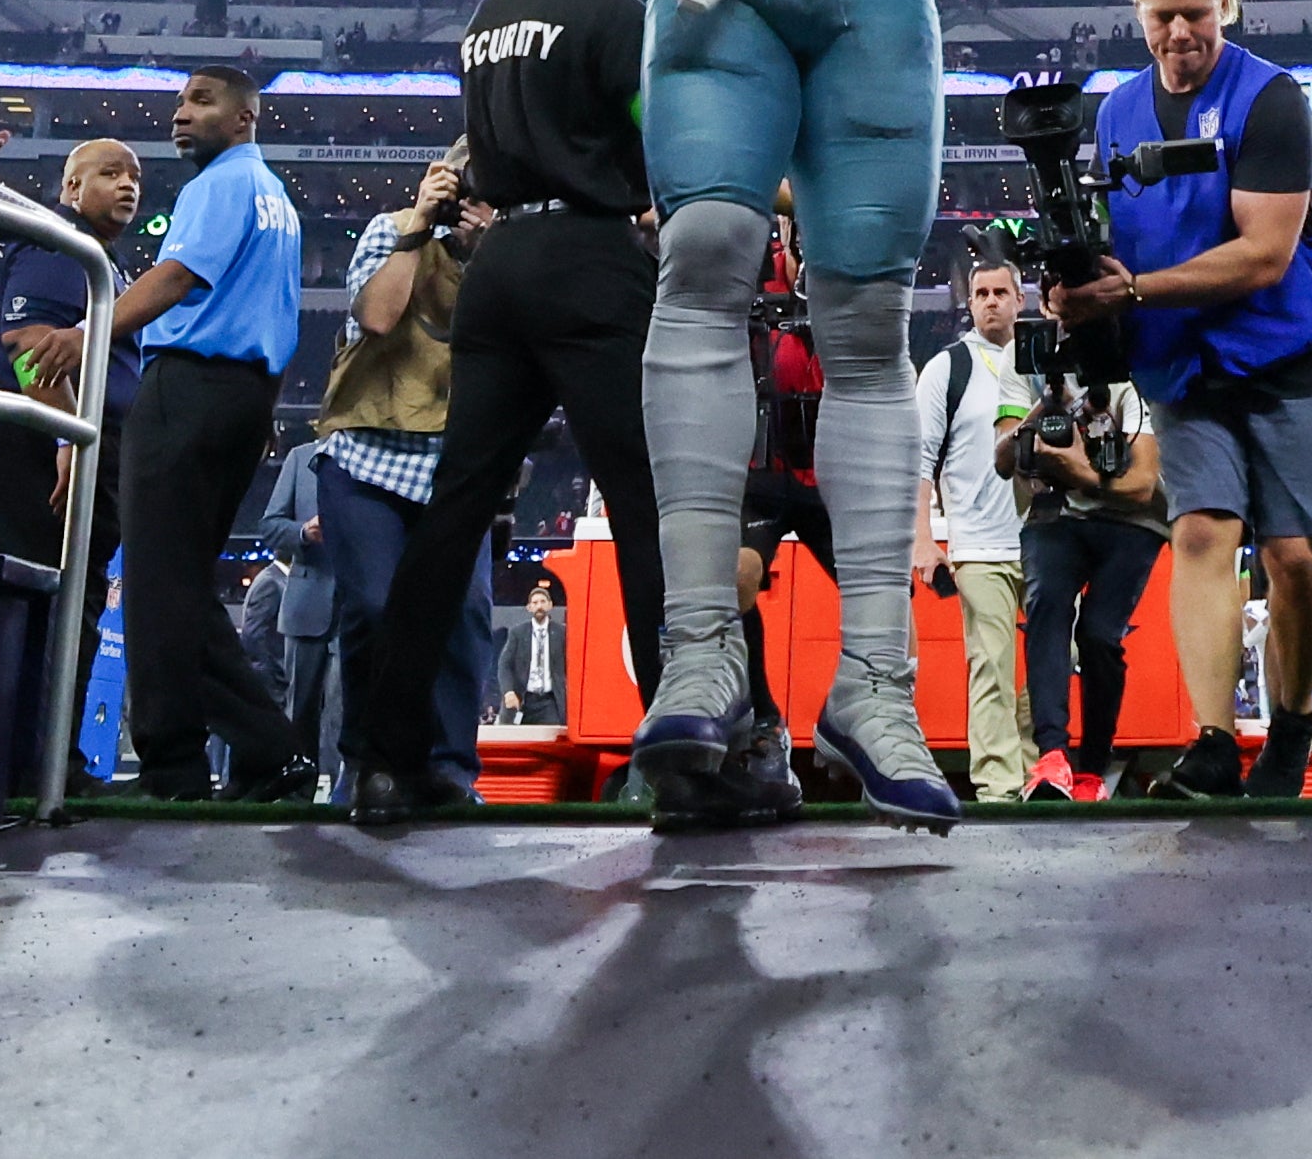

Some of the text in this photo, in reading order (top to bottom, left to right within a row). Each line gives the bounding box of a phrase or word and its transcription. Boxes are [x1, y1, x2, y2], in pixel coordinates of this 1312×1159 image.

[461, 20, 564, 73] ECURITY
[317, 148, 372, 159] DARREN
[378, 149, 446, 160] WOODSON
[942, 149, 962, 160] EL
[964, 148, 997, 159] IRVIN
